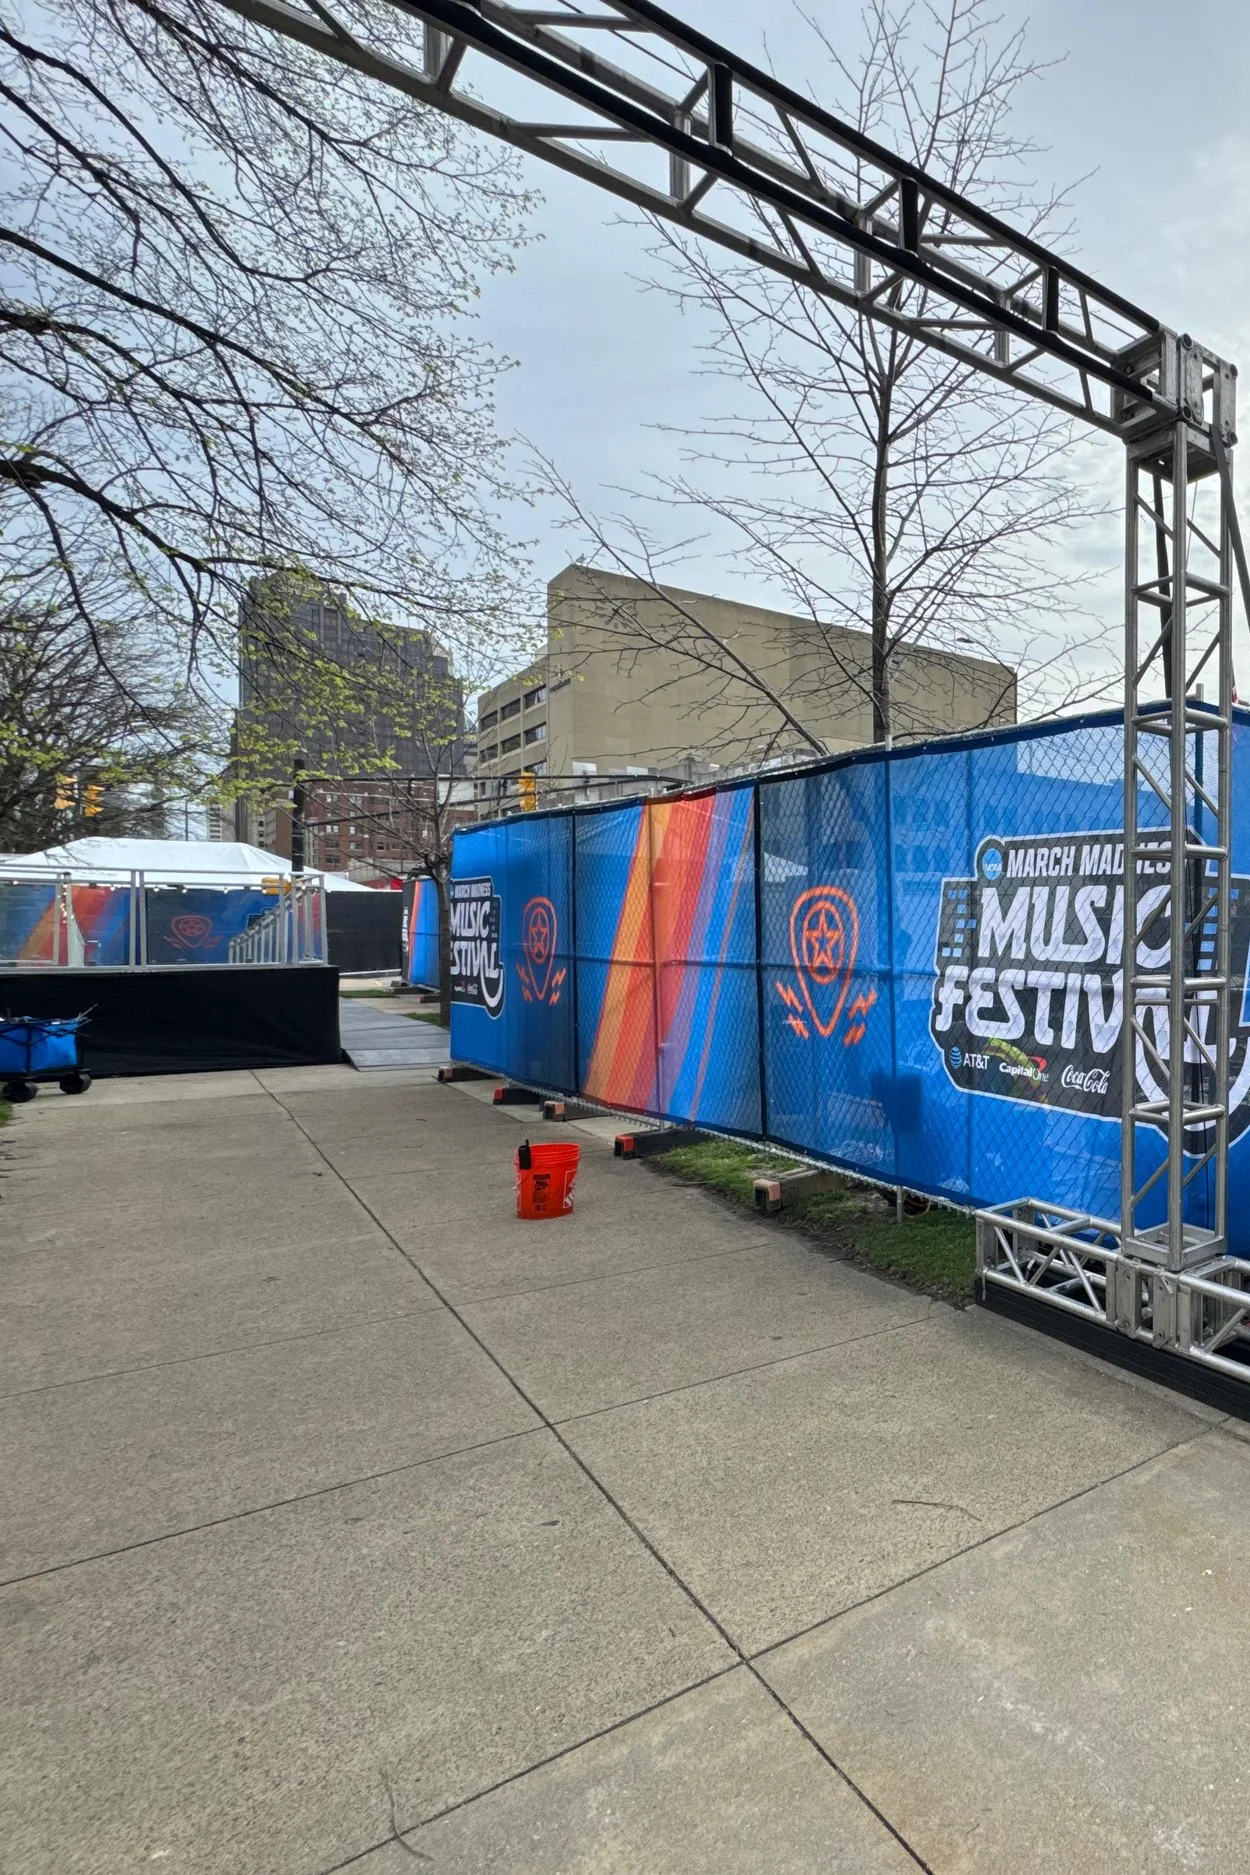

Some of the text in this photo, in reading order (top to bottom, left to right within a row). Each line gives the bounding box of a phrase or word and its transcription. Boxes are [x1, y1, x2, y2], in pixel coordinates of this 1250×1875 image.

[1006, 846, 1076, 878] MARCH
[450, 901, 490, 938] MUSIC
[978, 884, 1172, 970] MUSIC
[450, 938, 503, 995] STIVAL
[963, 1052, 990, 1070] AT&T
